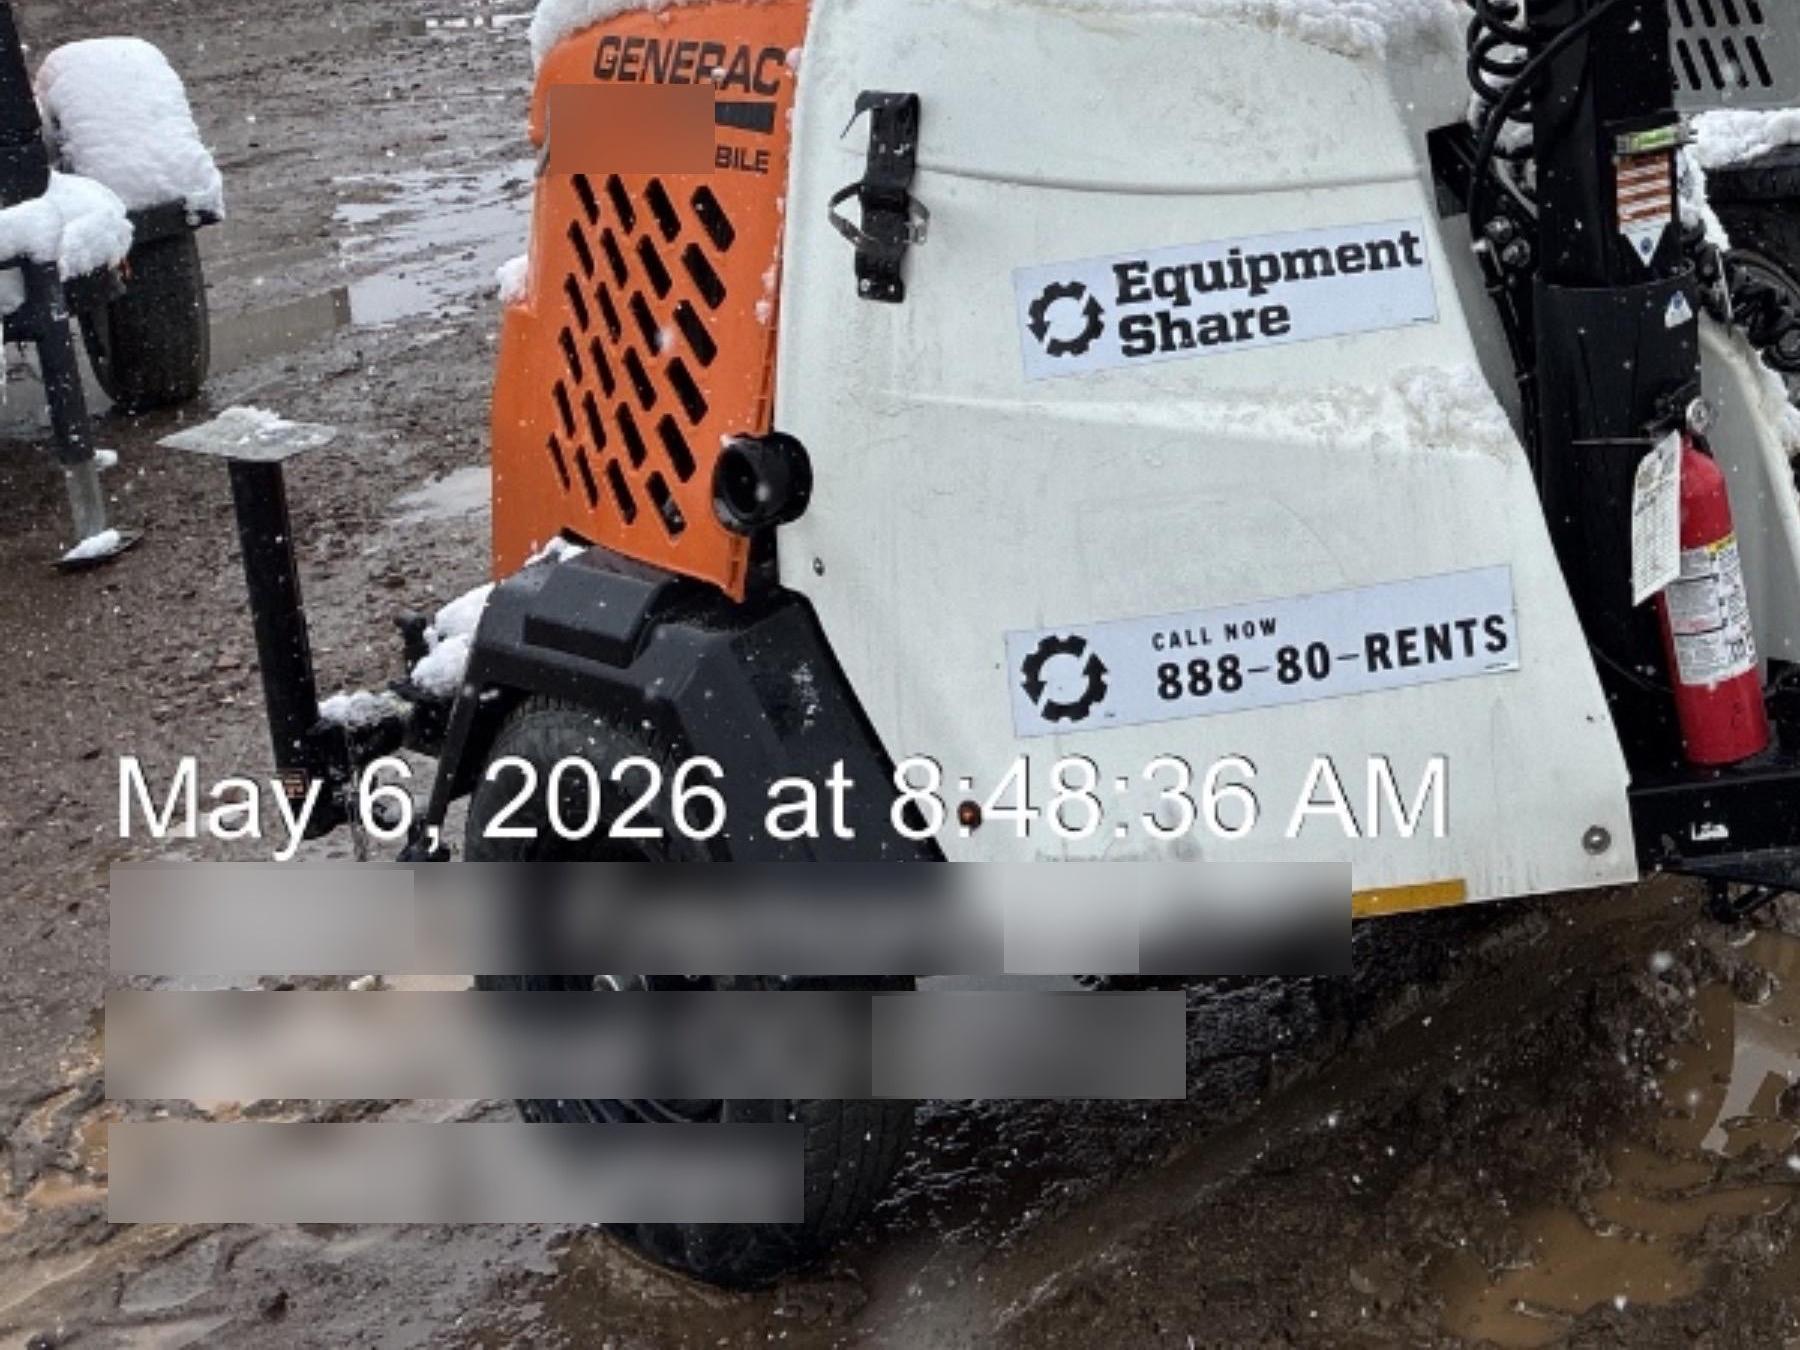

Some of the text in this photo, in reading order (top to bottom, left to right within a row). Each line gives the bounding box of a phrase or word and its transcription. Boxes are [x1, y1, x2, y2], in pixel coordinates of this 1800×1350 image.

[593, 34, 787, 97] GENERAC
[1112, 229, 1424, 308] Equipment
[1116, 304, 1292, 358] Share
[1151, 616, 1279, 652] CALL NOW
[1156, 613, 1510, 702] 888-80-RENTS
